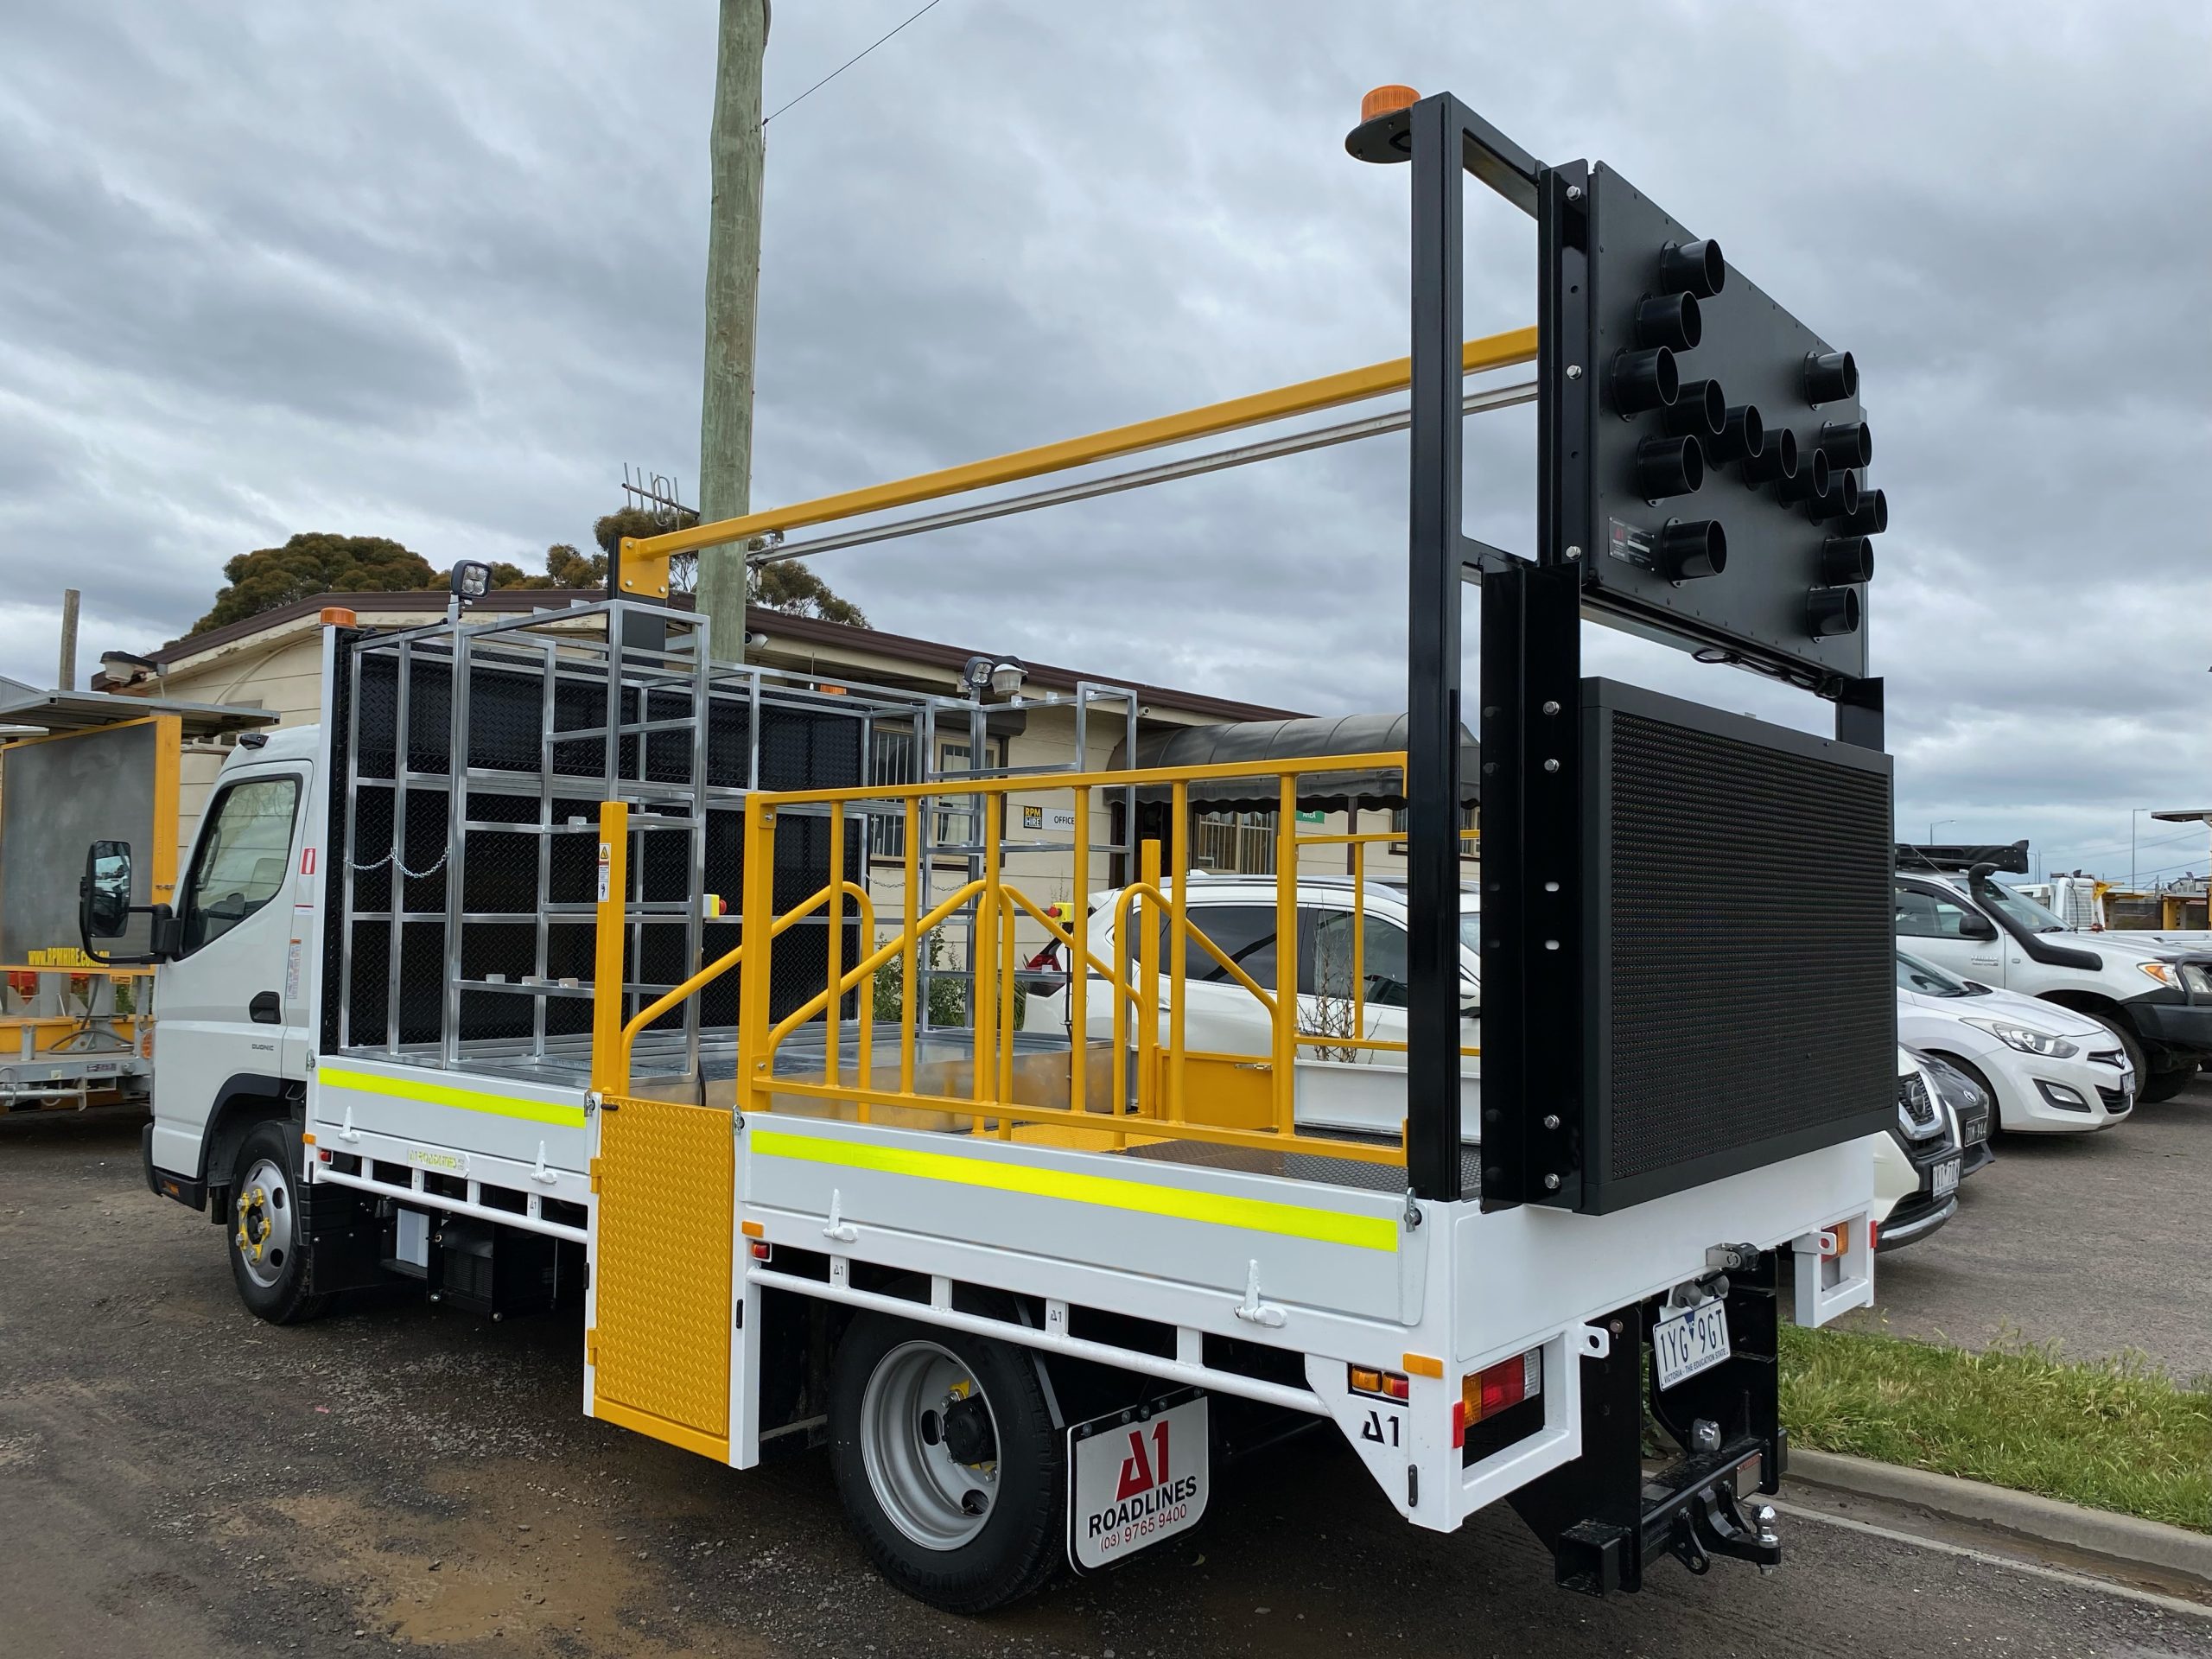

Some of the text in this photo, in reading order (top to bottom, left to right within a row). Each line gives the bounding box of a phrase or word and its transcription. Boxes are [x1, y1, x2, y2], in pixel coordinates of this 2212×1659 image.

[1025, 807, 1041, 817] RPM
[1054, 816, 1075, 825] OFFICE
[833, 1264, 843, 1276] A1
[1050, 1309, 1062, 1323] A1
[1664, 1369, 1683, 1383] VICTORIA
[1685, 1363, 1694, 1373] THE
[1694, 1353, 1715, 1370] EDUCATION
[1715, 1347, 1726, 1359] STATE
[1361, 1410, 1399, 1447] A1
[1116, 1420, 1169, 1502] A1
[1089, 1476, 1197, 1538] ROADLINES
[1100, 1503, 1187, 1553] (03) 9765 9400
